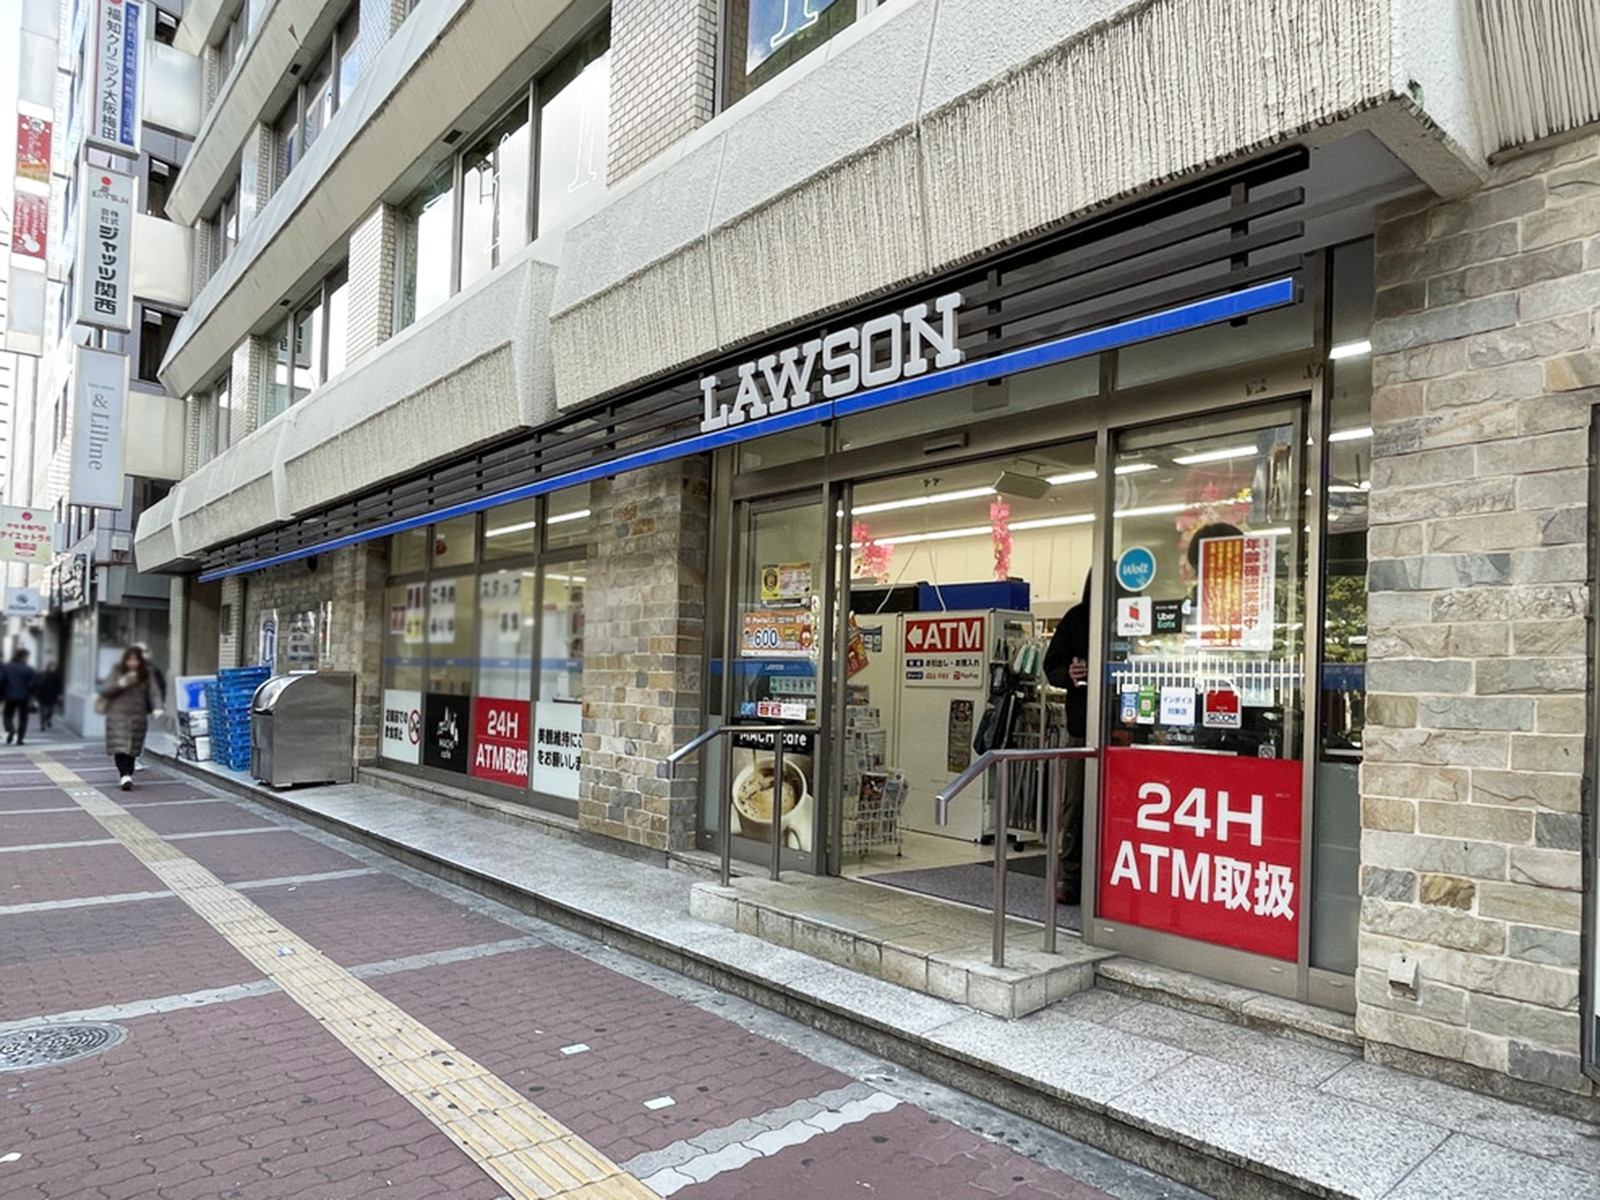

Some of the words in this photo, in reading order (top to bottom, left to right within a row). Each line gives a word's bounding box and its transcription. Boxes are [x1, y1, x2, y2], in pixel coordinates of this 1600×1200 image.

[94, 224, 119, 315] ジャッツ関西
[700, 291, 962, 432] LAWSON
[1122, 562, 1148, 576] Wolt
[1157, 612, 1176, 621] Uber
[754, 628, 778, 647] 600
[923, 621, 981, 649] ATM
[1163, 696, 1192, 704] インボイス
[487, 709, 518, 739] 24H
[1207, 713, 1237, 722] SECOM
[476, 743, 528, 776] ATM取扱
[1135, 781, 1263, 847] 24H
[1109, 840, 1295, 920] ATM取扱
